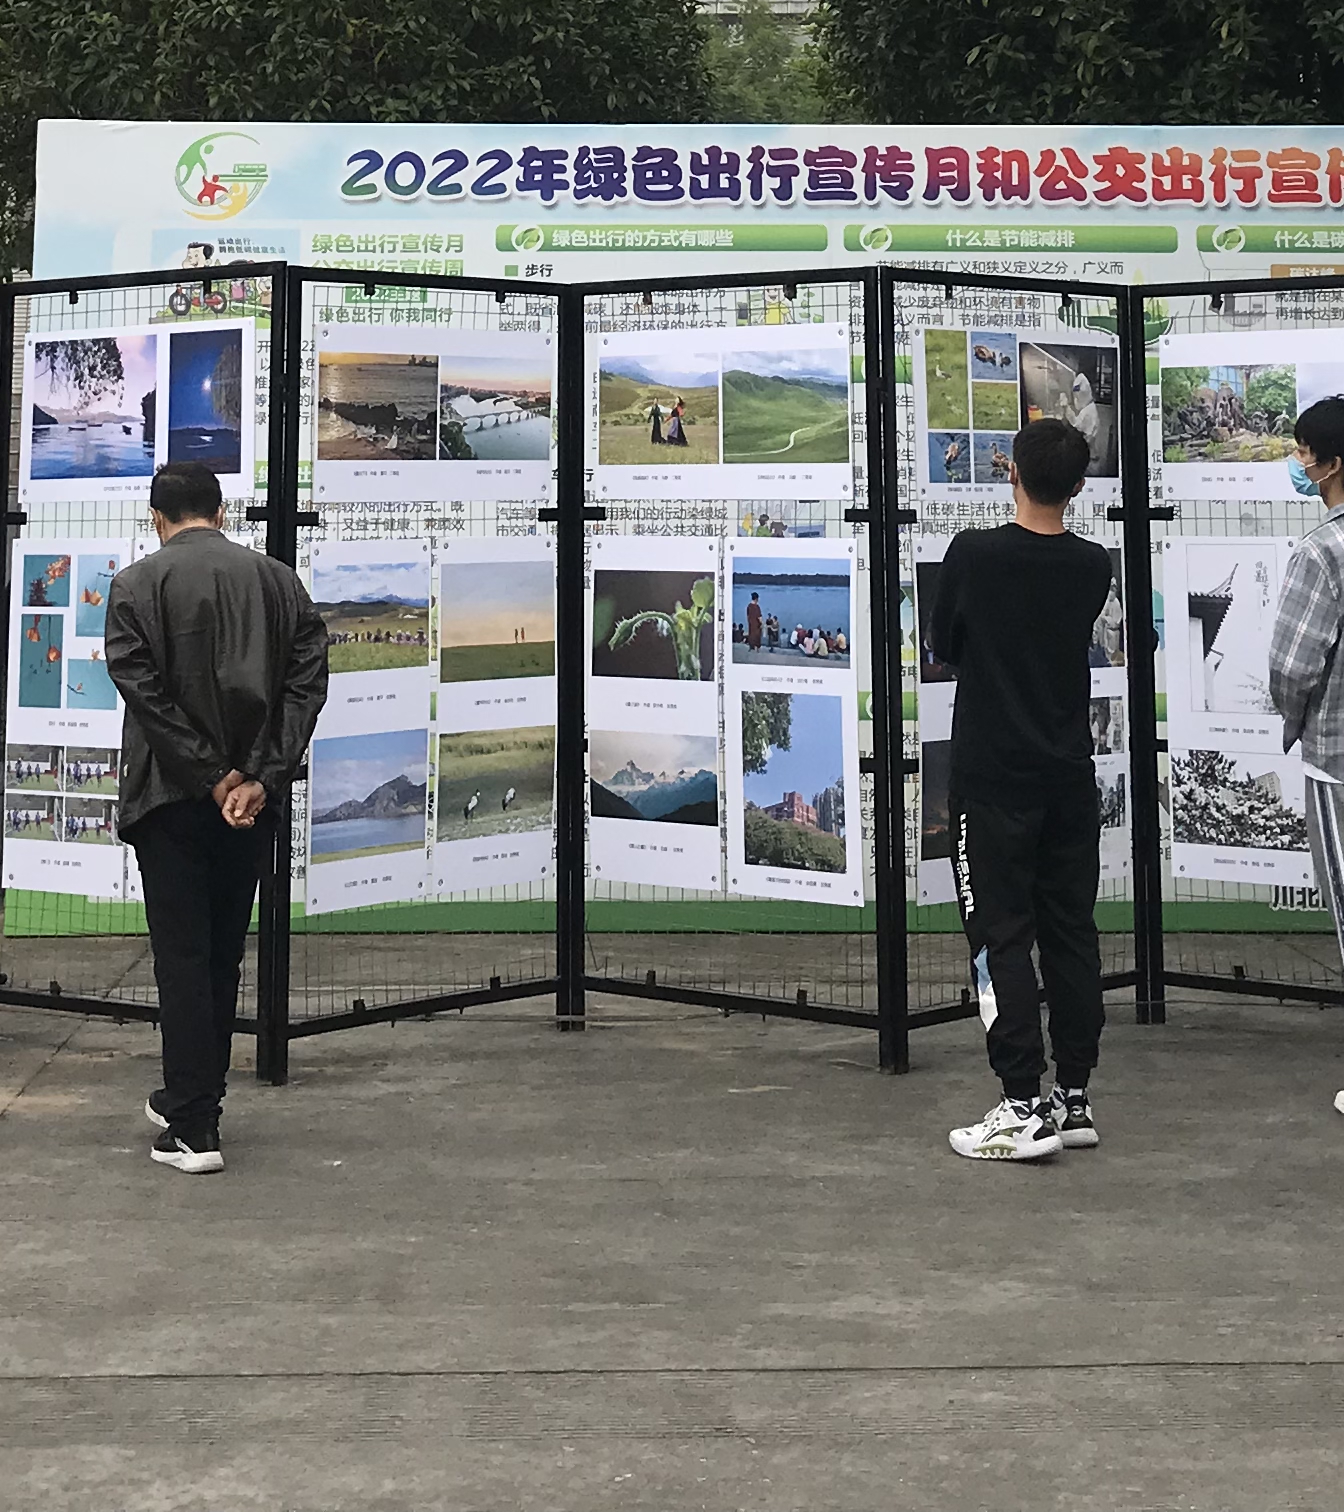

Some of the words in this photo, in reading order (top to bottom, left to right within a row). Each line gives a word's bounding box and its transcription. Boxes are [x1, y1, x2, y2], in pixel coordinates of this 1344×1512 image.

[312, 233, 464, 254] 绿色出行宣传月
[552, 229, 734, 247] 绿色出行的方式有哪些
[946, 230, 1075, 248] 什么是节能减排
[525, 264, 553, 277] 步行
[319, 307, 384, 324] 绿色出行
[389, 307, 453, 324] 你我同行
